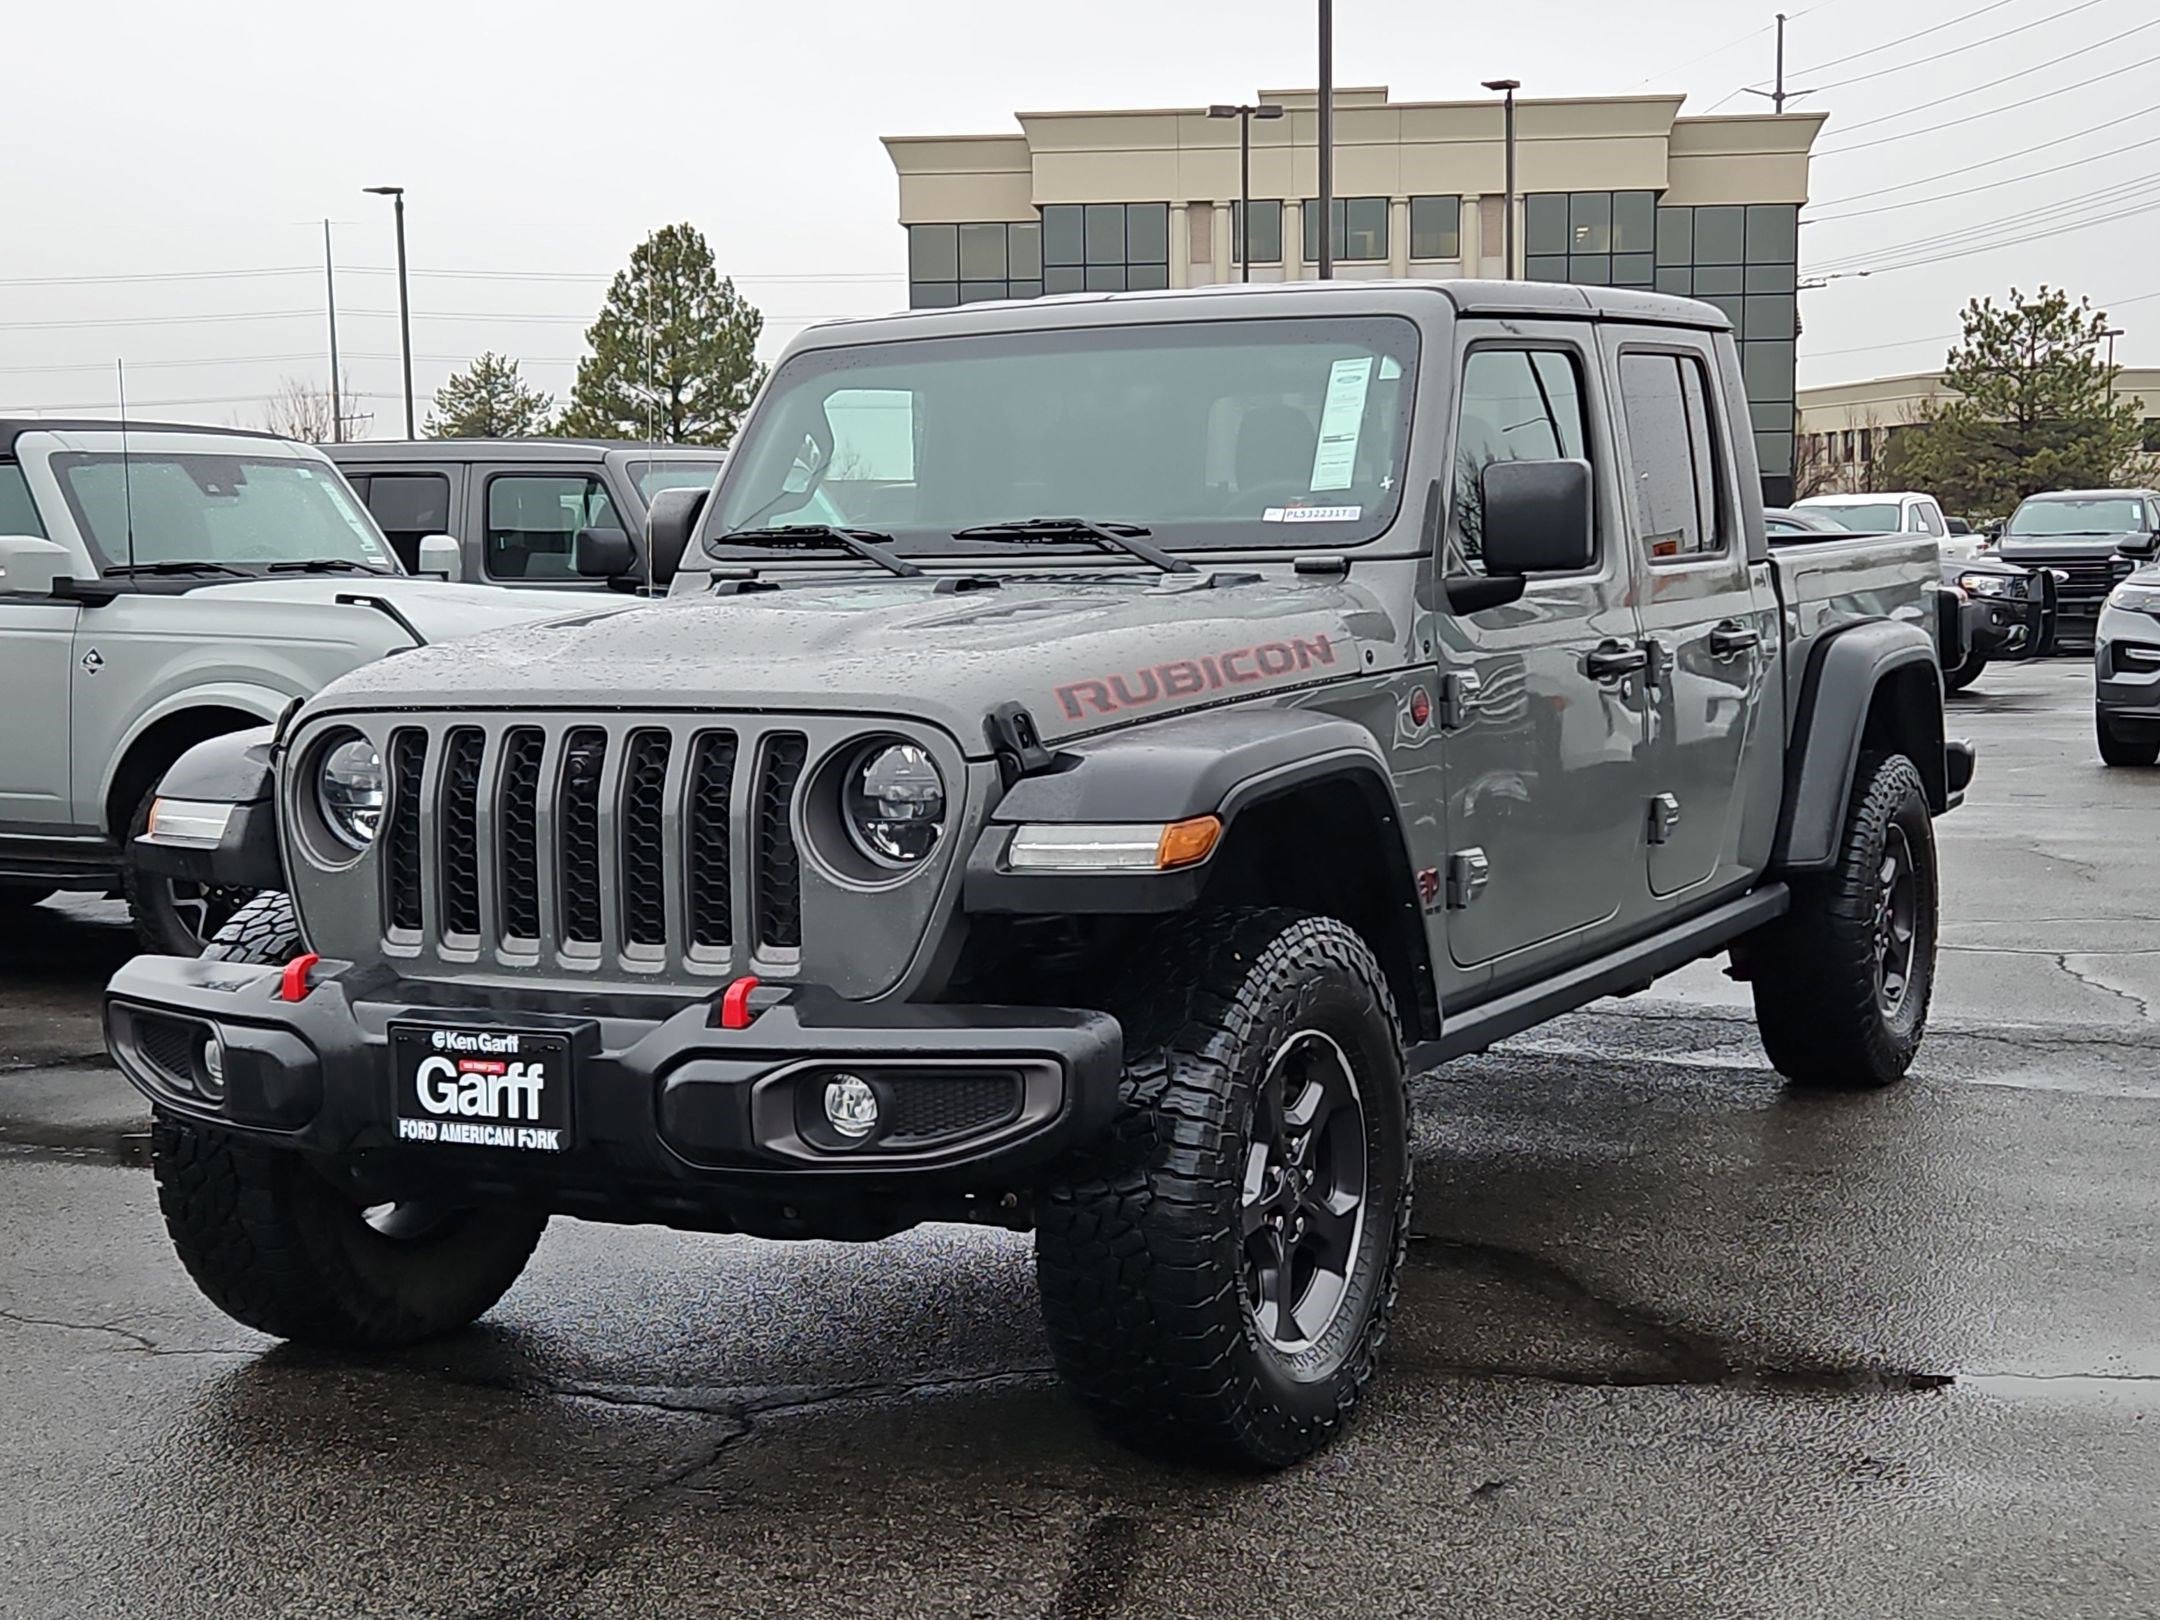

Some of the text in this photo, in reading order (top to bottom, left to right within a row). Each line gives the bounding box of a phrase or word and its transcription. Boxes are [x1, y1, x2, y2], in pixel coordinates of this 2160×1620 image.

[1054, 634, 1336, 720] RUBICON
[446, 1031, 519, 1053] Ken Garff
[416, 1056, 544, 1120] Garff
[400, 1119, 559, 1150] FORD AMERICAN FORK
